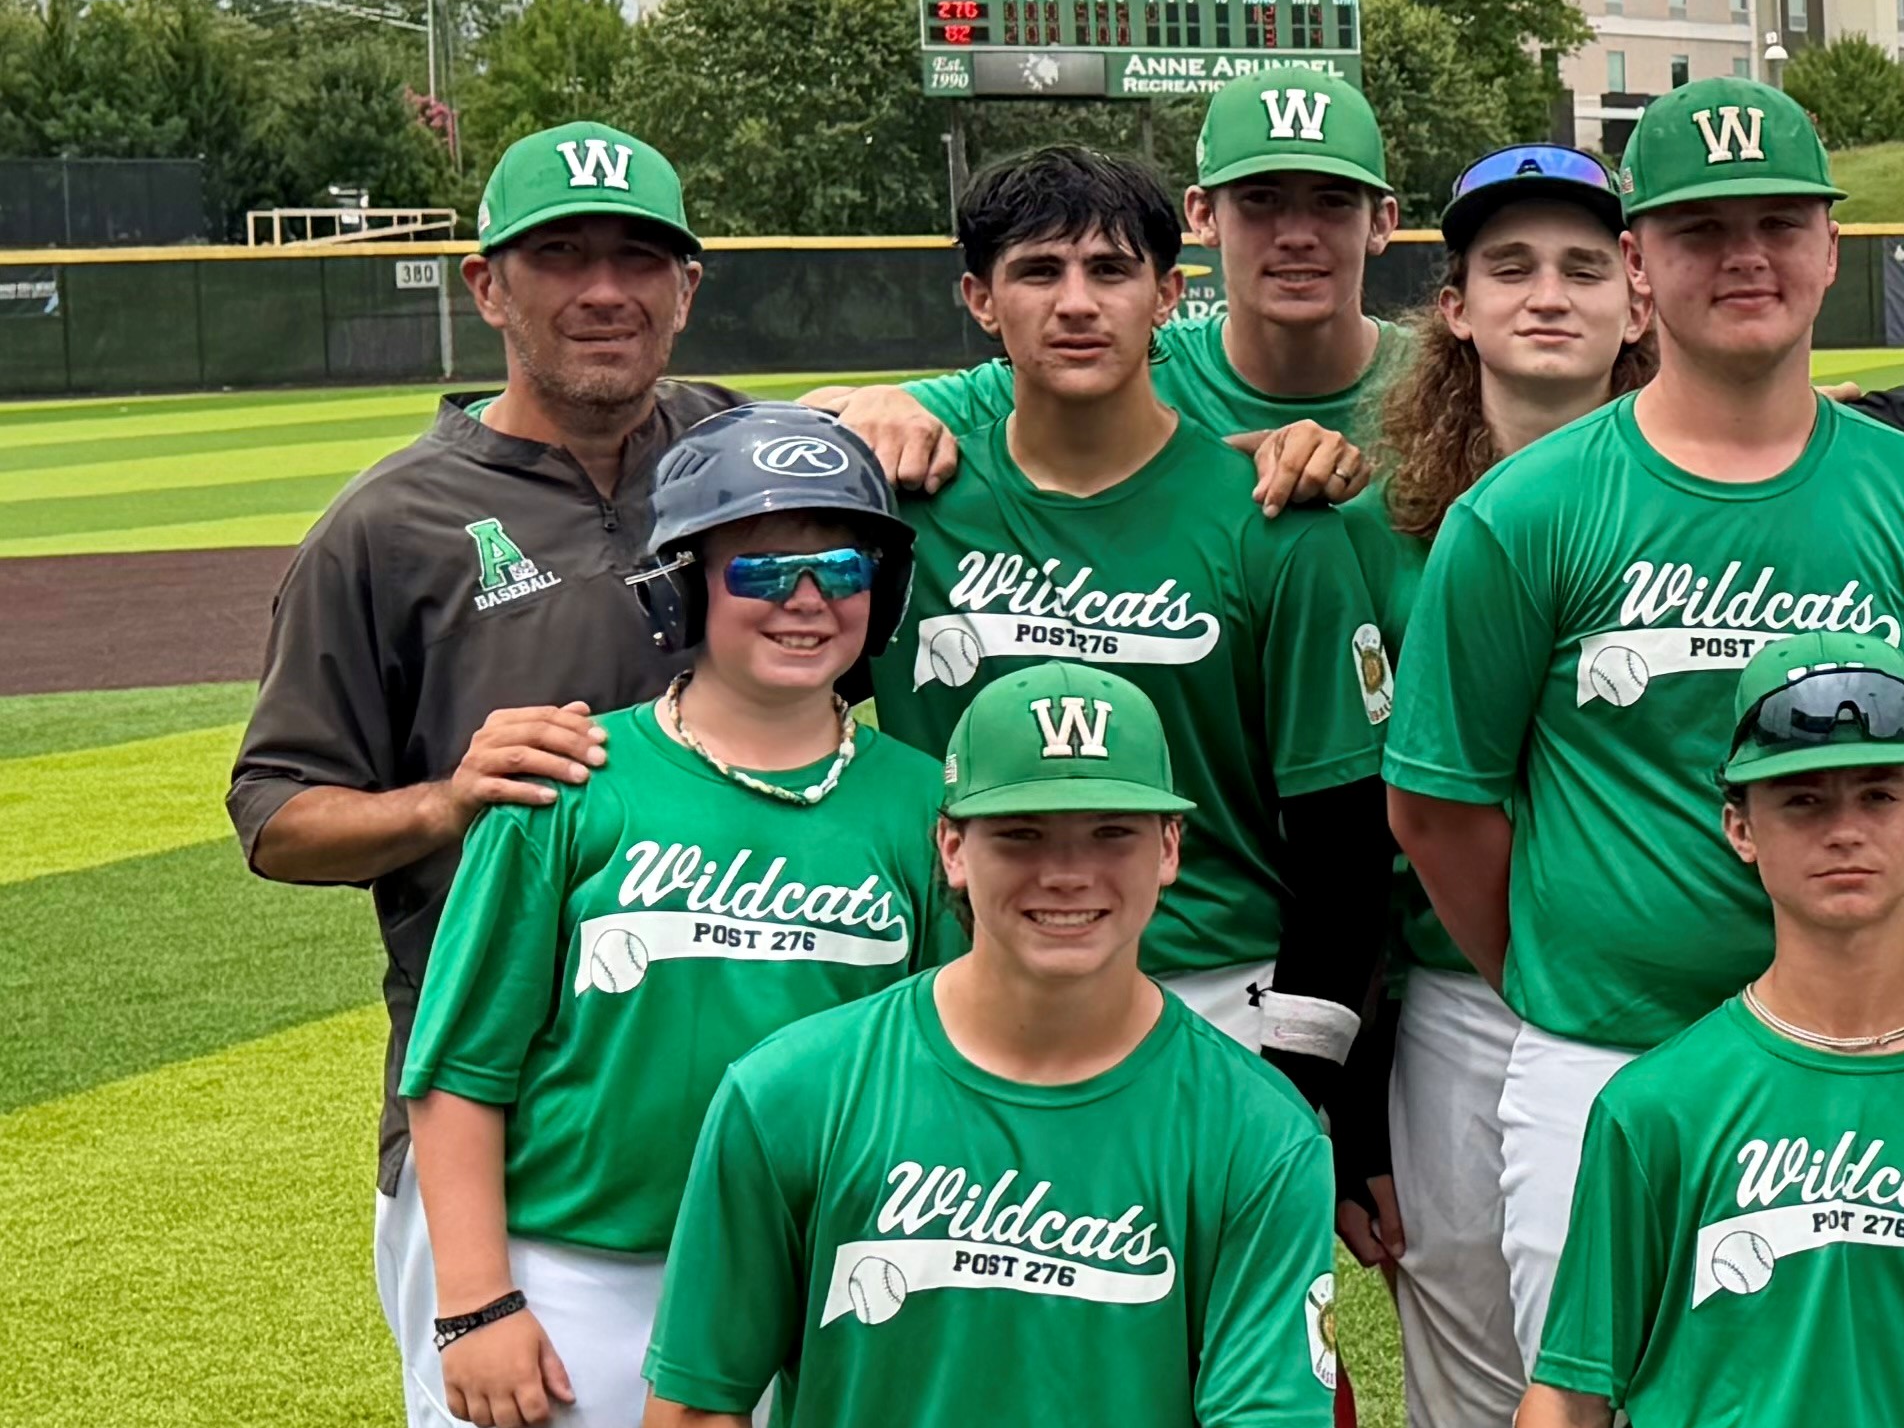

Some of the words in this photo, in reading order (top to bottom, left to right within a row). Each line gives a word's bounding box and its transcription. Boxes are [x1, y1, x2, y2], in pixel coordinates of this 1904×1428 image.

[936, 0, 978, 20] 276
[945, 24, 972, 43] 82
[930, 73, 969, 89] 1990
[932, 56, 965, 72] Est.
[1124, 54, 1206, 76] ANNE
[1123, 77, 1227, 93] RECREATIO
[1259, 88, 1332, 141] W
[1692, 105, 1766, 164] W
[555, 139, 634, 191] W
[401, 264, 434, 284] 380
[465, 518, 526, 592] A
[474, 571, 562, 611] BASEBALL
[946, 551, 1198, 632] Wildcats
[1618, 560, 1880, 634] Wildcats
[1689, 636, 1756, 659] POST
[1029, 696, 1114, 758] W
[617, 841, 903, 931] Wildcats
[692, 922, 763, 951] POST
[770, 928, 816, 953] 276
[877, 1160, 1157, 1266] Wildcats
[951, 1250, 1018, 1278] POST
[1023, 1259, 1077, 1288] 276
